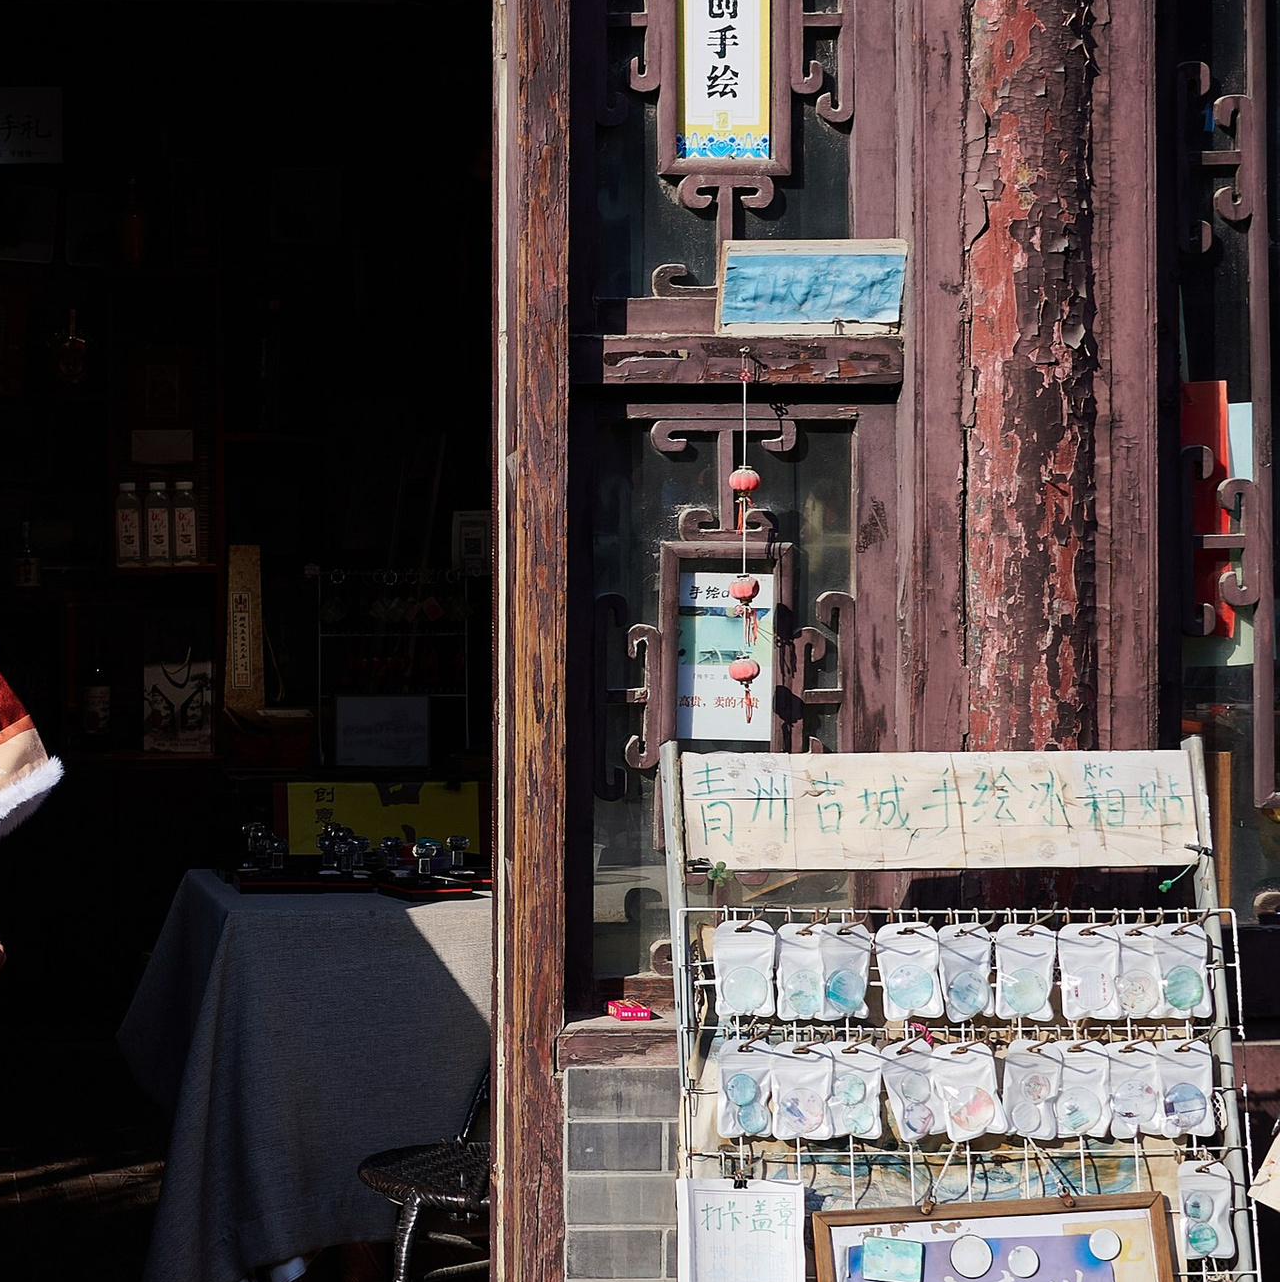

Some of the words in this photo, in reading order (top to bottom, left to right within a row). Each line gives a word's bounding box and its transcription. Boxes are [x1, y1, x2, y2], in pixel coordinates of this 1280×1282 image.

[313, 786, 336, 836] 創意
[690, 760, 1184, 846] 青州古城手绘冰箱贴
